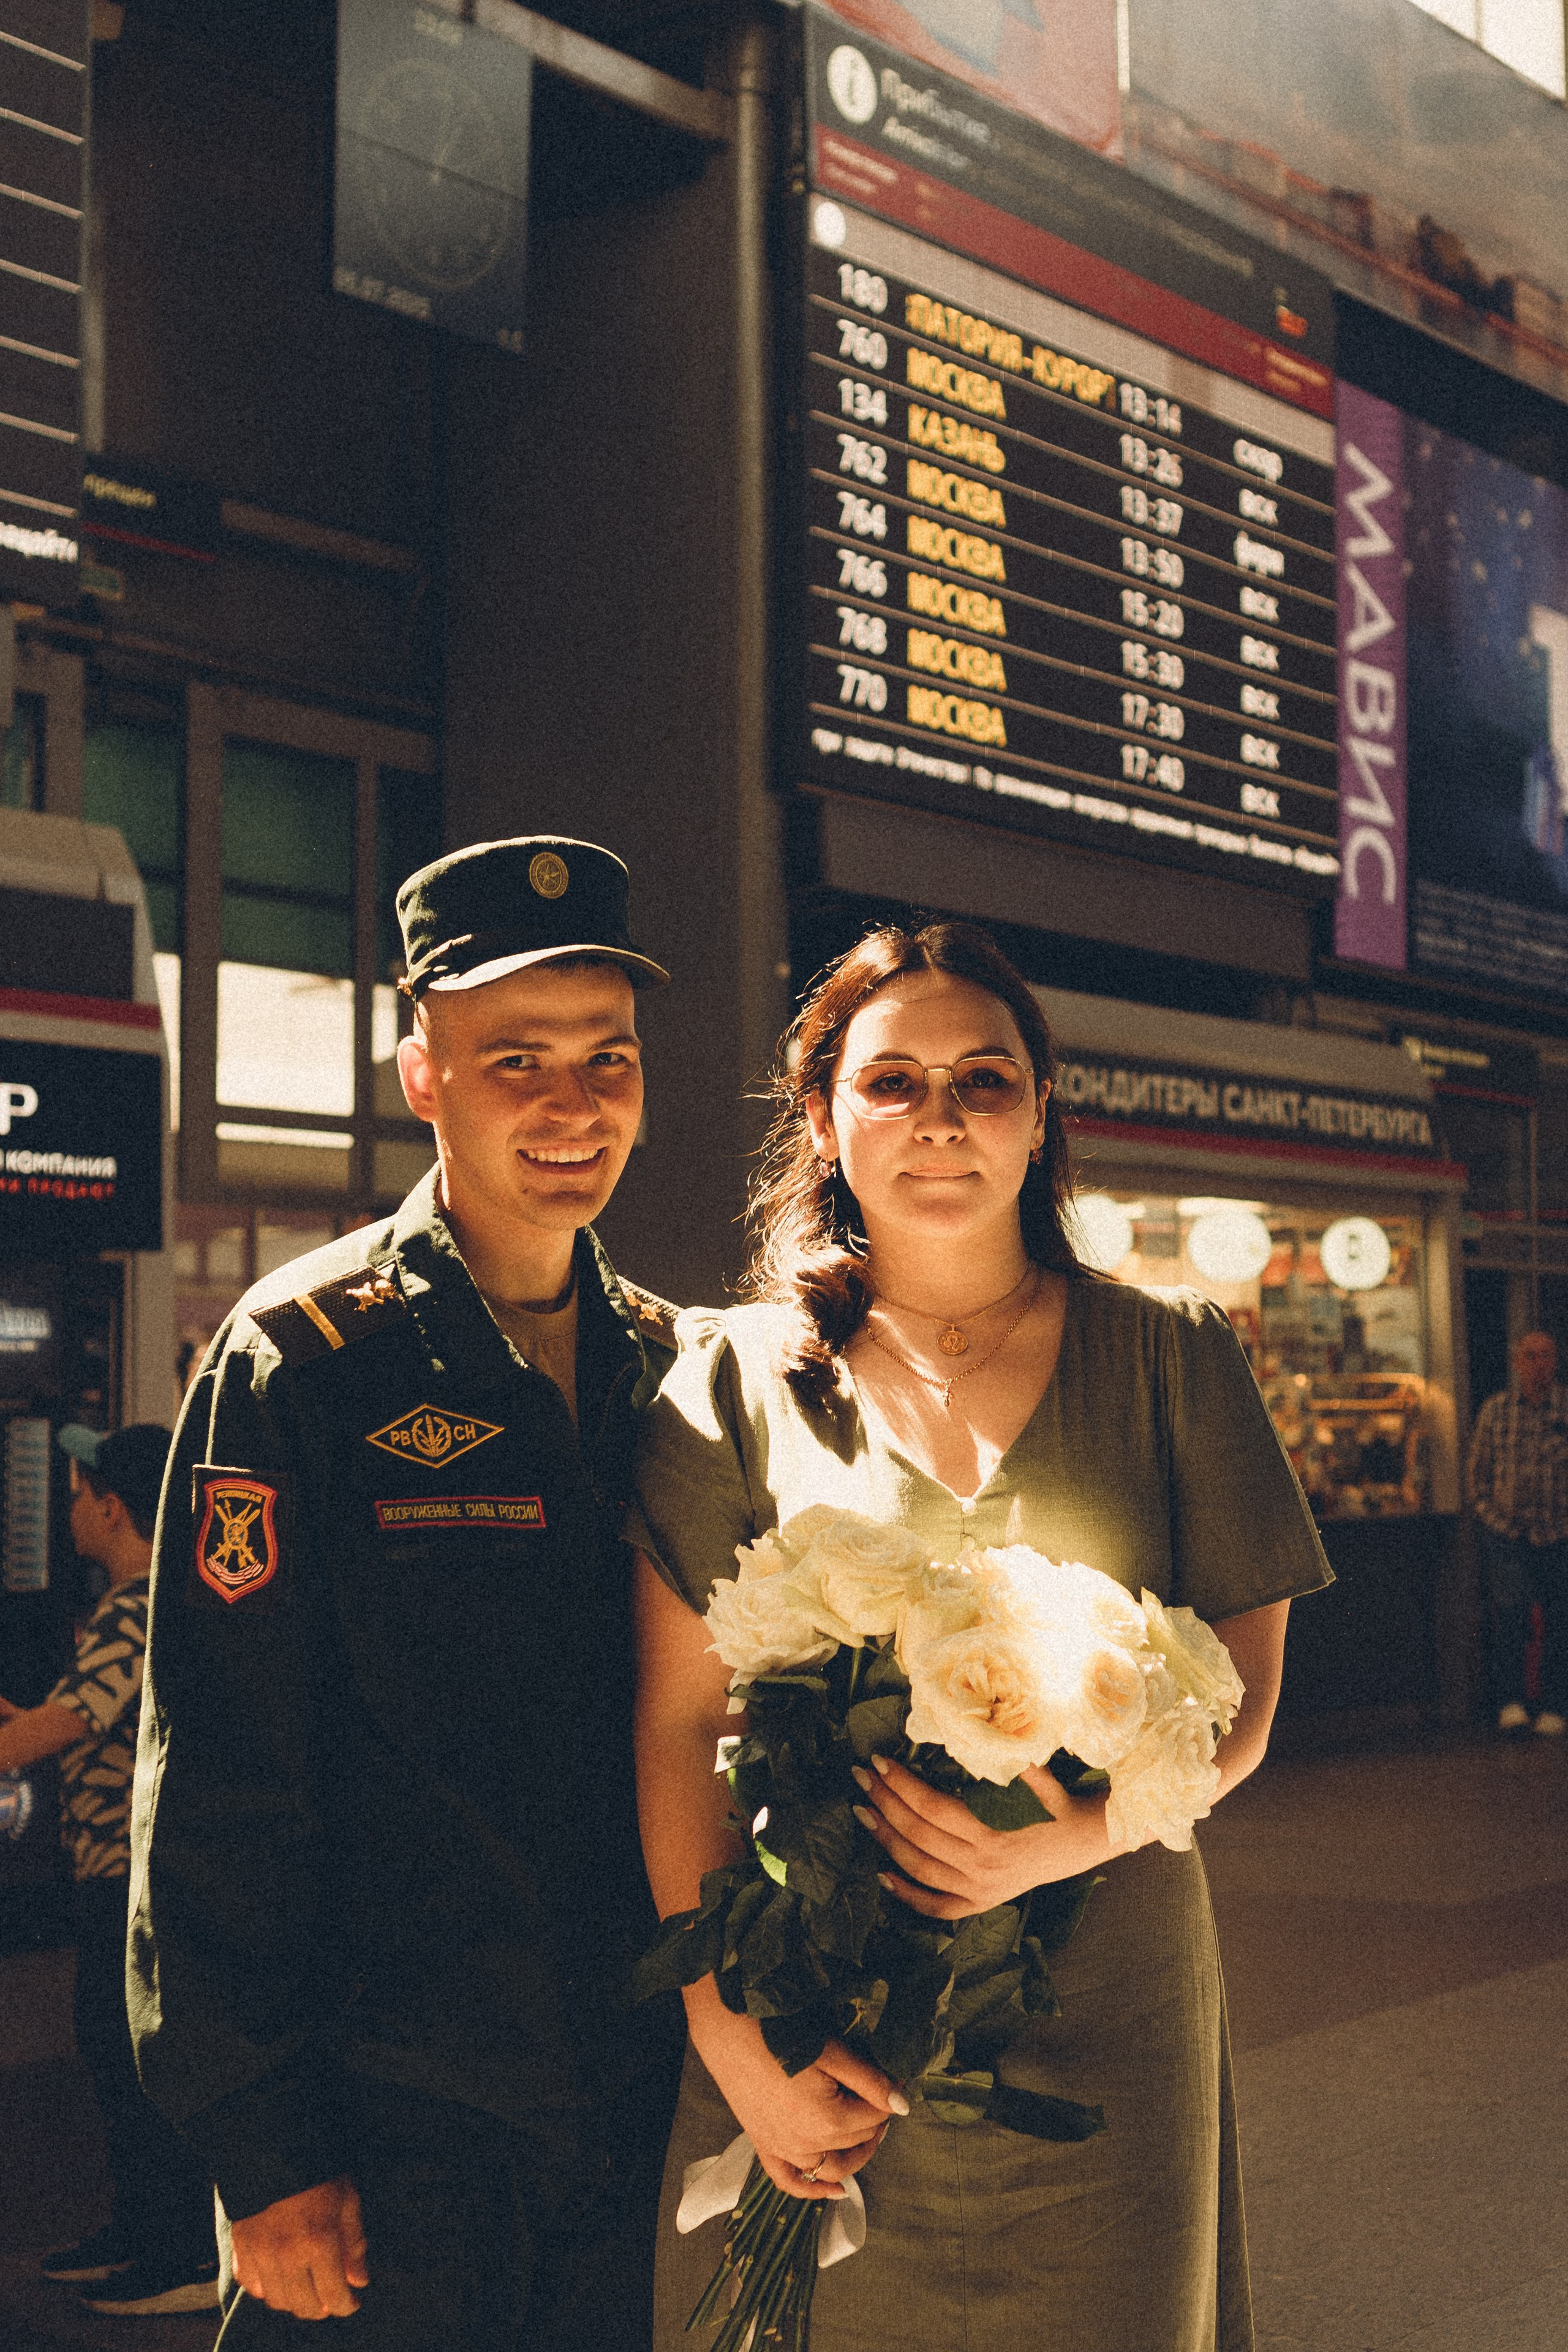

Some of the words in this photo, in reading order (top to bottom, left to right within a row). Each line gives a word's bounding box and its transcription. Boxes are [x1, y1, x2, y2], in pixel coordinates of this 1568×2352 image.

[837, 319, 888, 369] 760
[908, 349, 1006, 419] МОСКВА
[838, 379, 888, 427] 134
[908, 404, 1006, 473] КАЗАНЬ
[837, 434, 888, 484] 762
[908, 459, 1006, 528] МОСКВА
[1120, 537, 1184, 588] 13:50
[837, 492, 888, 541] 764
[908, 514, 1006, 582] МОСКВА
[1120, 588, 1185, 639] 15:20
[837, 549, 888, 598] 766
[908, 571, 1006, 637] МОСКВА
[837, 607, 888, 655] 768
[908, 628, 1006, 692] МОСКВА
[1343, 441, 1396, 905] МАВИС
[837, 665, 888, 712] 770
[908, 685, 1006, 747] МОСКВА
[1222, 1083, 1434, 1146] САНКТ-ПЕТЕРБУРГА
[6, 1149, 118, 1179] КОМПАНИЯ
[390, 1430, 412, 1446] РВ
[453, 1423, 477, 1441] СН
[382, 1502, 463, 1521] ВООРУЖЕННЫЕ
[466, 1502, 496, 1518] СИЛЫ
[497, 1503, 539, 1520] РОССИИ
